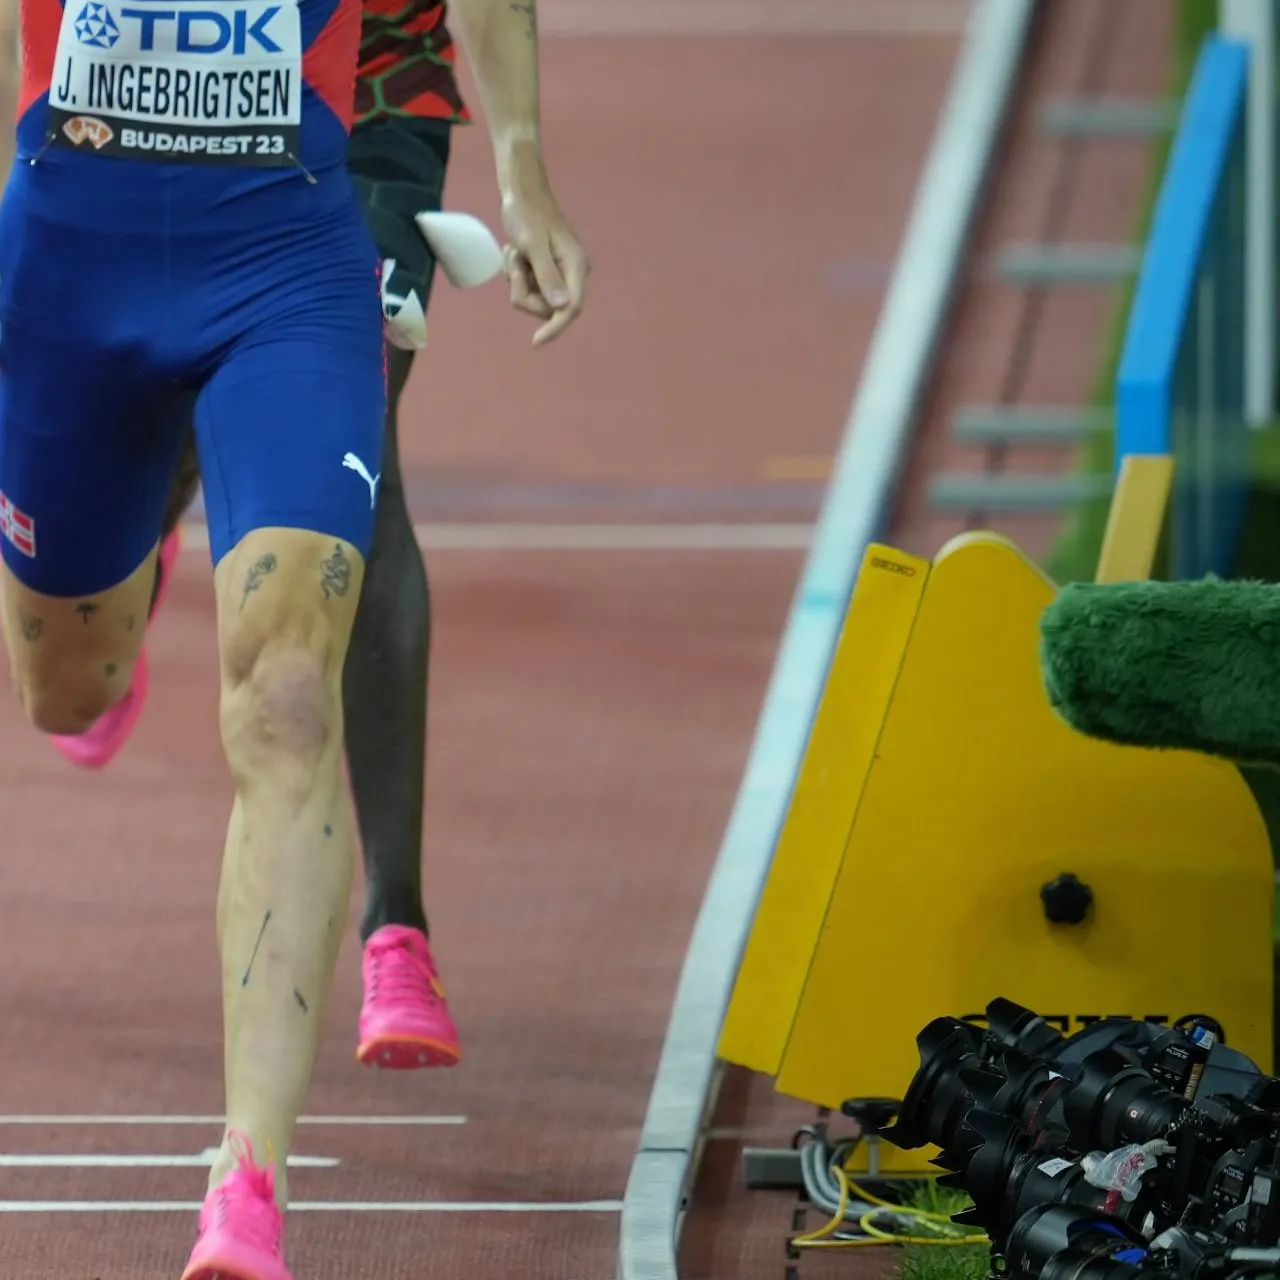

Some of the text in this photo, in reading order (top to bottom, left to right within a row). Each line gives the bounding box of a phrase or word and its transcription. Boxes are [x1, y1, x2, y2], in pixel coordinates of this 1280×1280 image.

[120, 5, 284, 56] TDK
[57, 55, 291, 118] J. INGEBRIGTSEN
[119, 127, 285, 155] BUDAPEST 23
